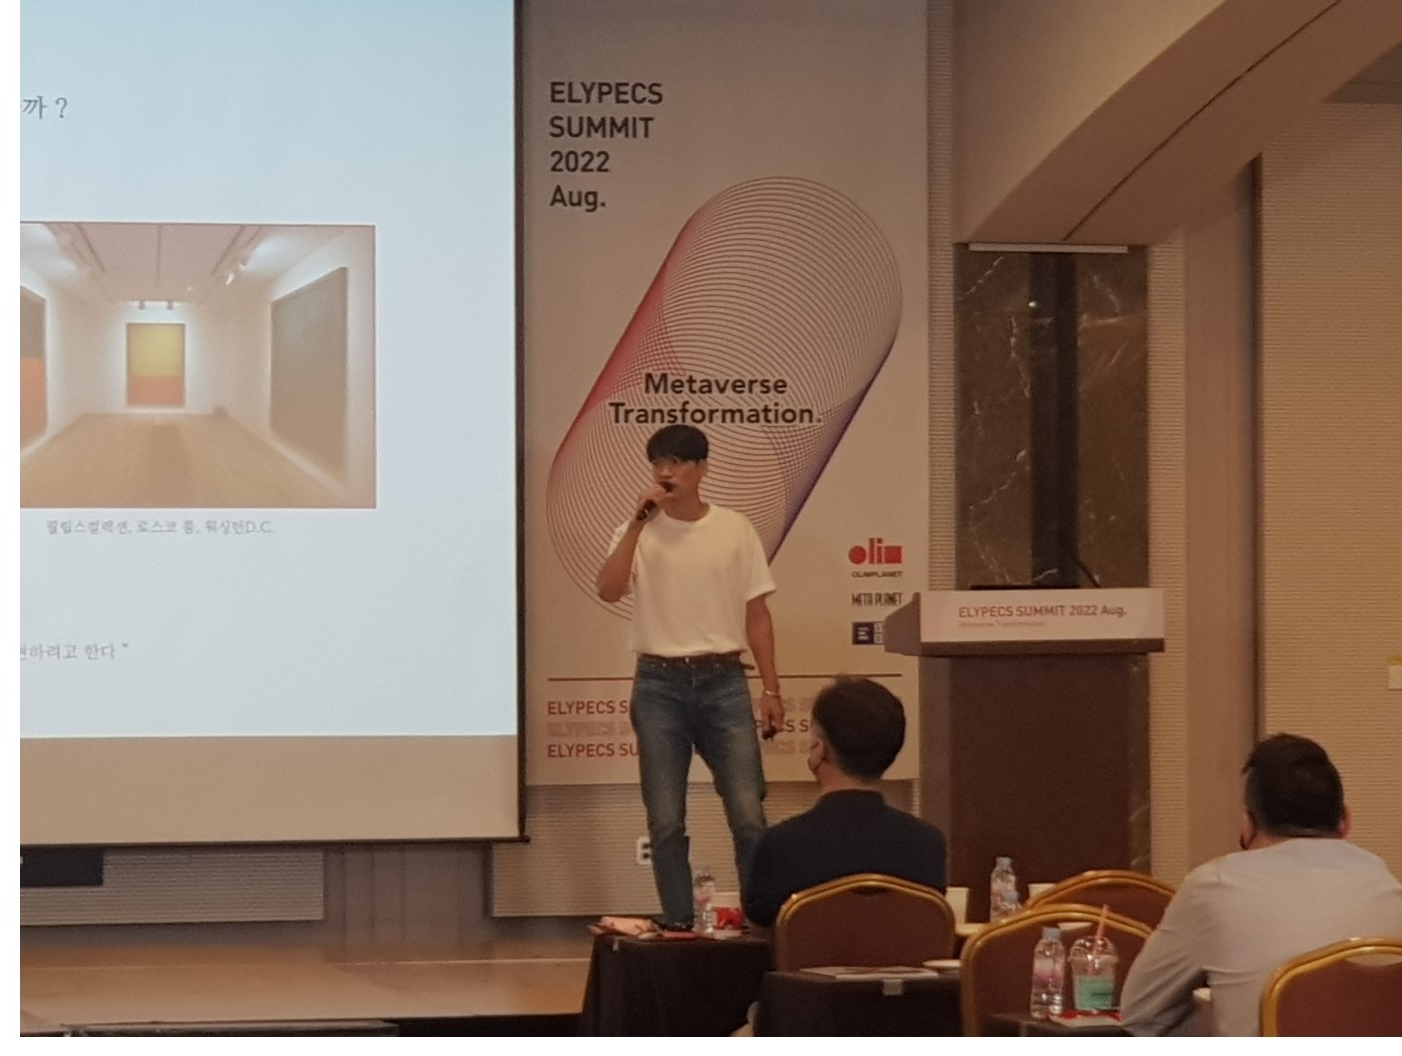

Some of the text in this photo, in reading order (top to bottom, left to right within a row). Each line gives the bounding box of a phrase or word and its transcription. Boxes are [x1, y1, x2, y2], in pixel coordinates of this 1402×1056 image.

[549, 81, 664, 104] ELYPECS
[549, 116, 655, 138] SUMMIT
[549, 150, 610, 172] 2022
[549, 185, 607, 212] Aug.
[644, 372, 788, 395] Metaverse
[608, 401, 823, 424] Transformation.
[958, 604, 1127, 618] ELYPECS SUMMIT 2022 Aug.
[547, 700, 616, 715] ELYPECS
[547, 742, 615, 758] ELYPECS
